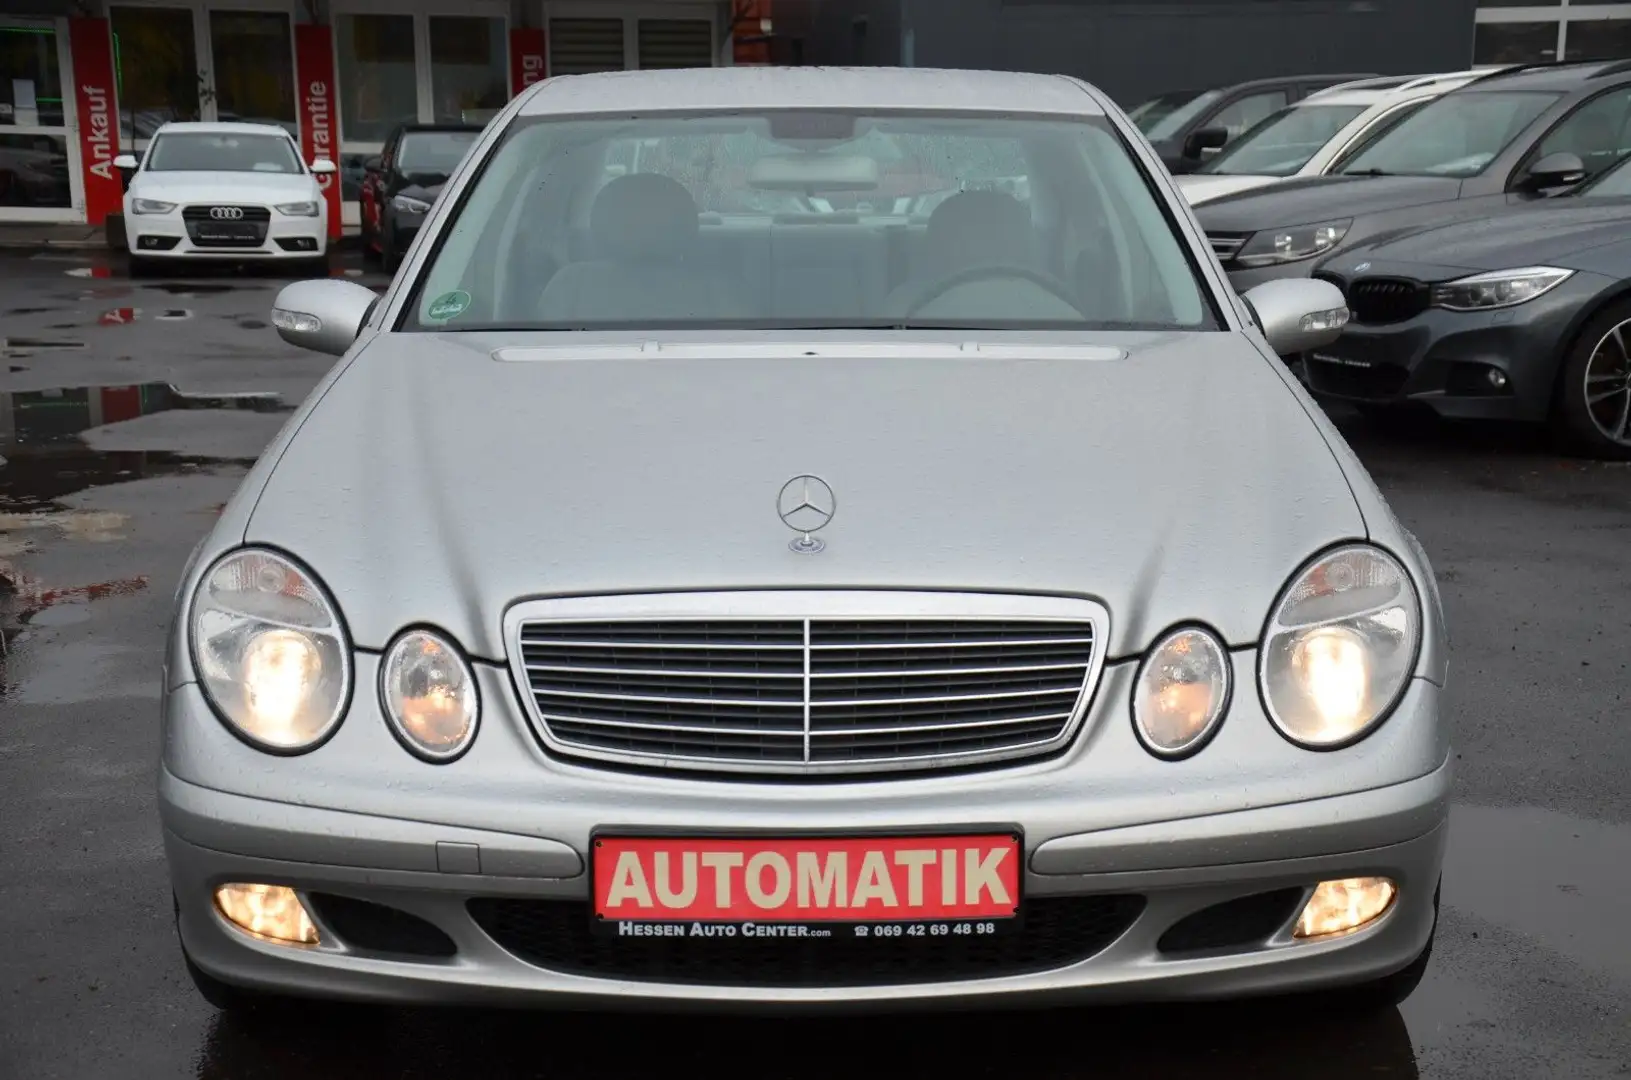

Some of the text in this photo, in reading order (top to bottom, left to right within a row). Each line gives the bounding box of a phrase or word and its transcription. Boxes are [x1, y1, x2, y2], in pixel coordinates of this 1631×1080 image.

[82, 84, 113, 180] Ankauf
[307, 81, 332, 189] Grantie
[606, 848, 1012, 909] AUTOMATIK
[873, 922, 995, 937] 069 42 69 48 98
